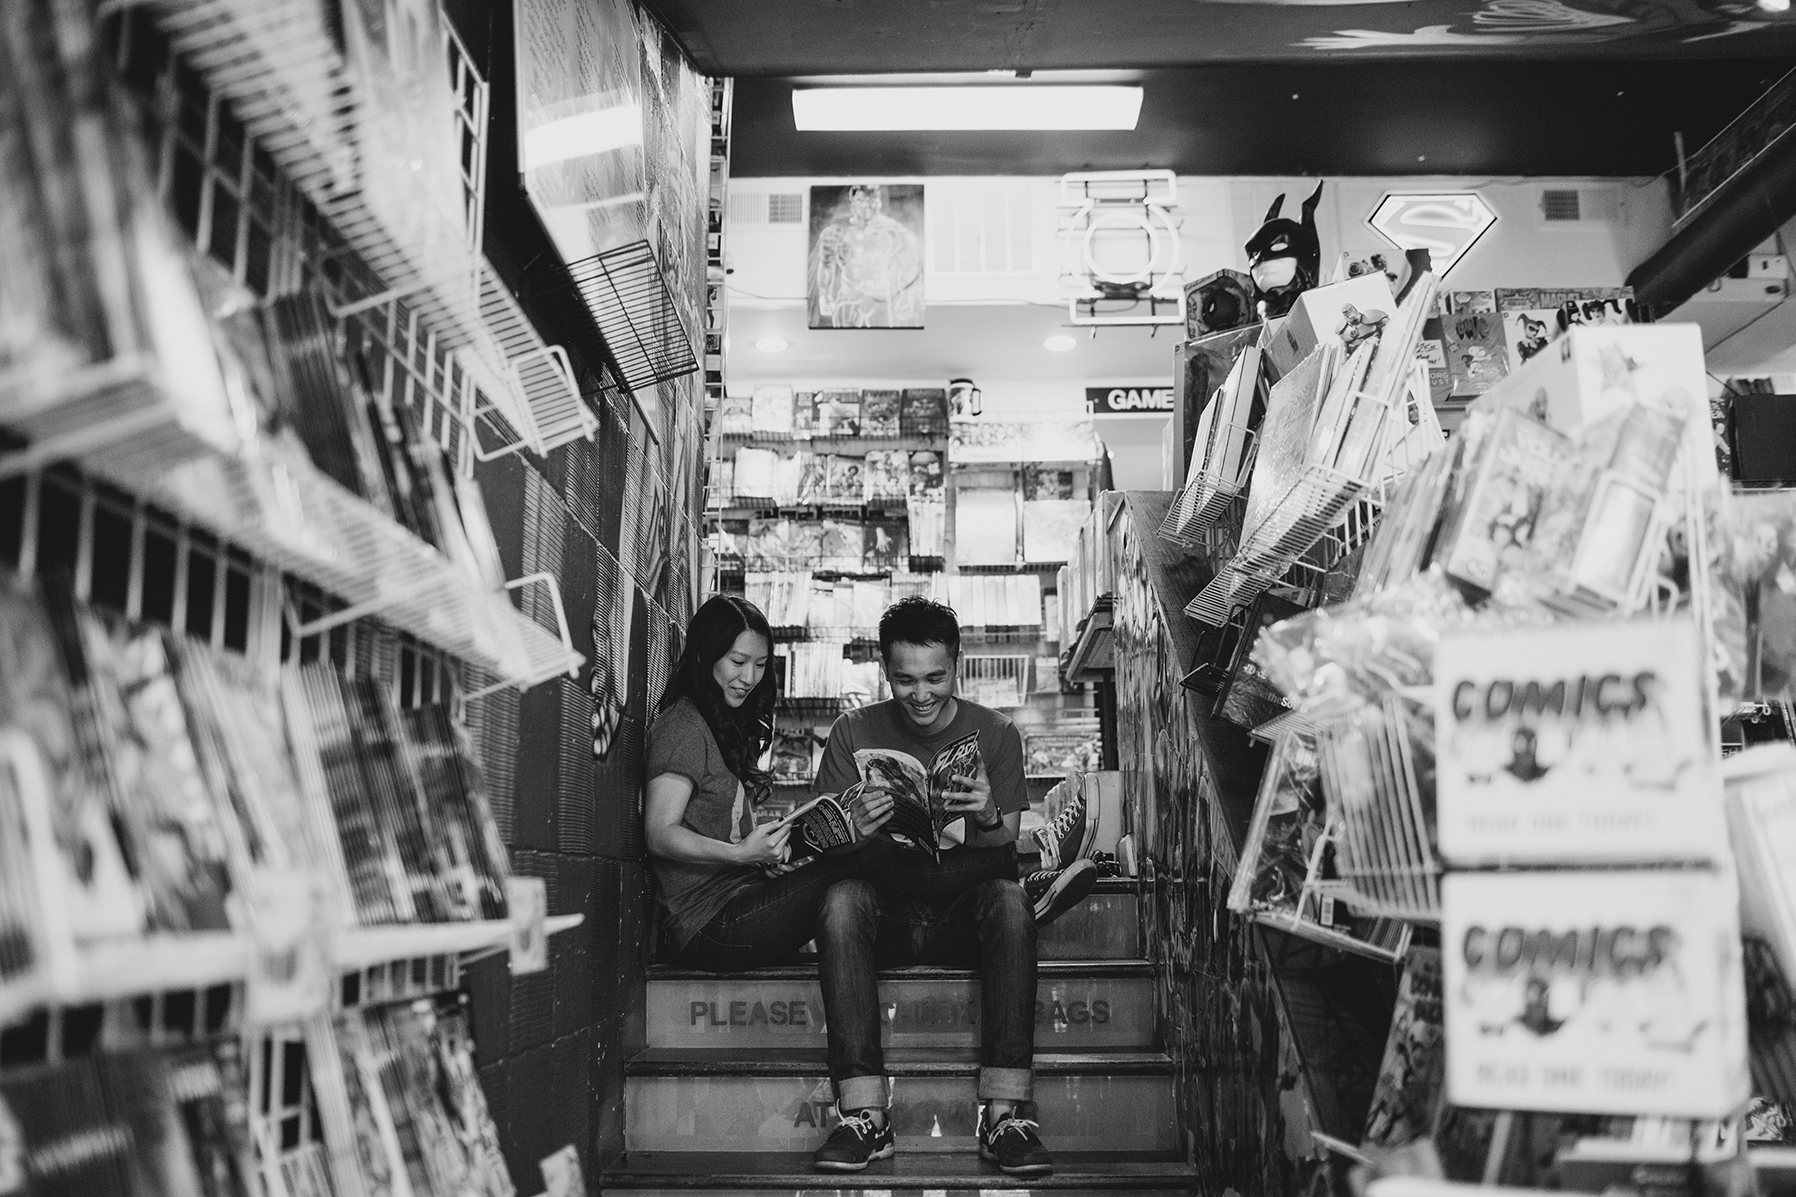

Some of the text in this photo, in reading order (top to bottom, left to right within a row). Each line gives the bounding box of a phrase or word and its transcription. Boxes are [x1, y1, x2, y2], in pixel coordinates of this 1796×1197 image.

[1453, 671, 1660, 722] COMICS
[1463, 924, 1676, 976] COMICS
[690, 1001, 806, 1026] PLEASE
[793, 1101, 833, 1128] AT
